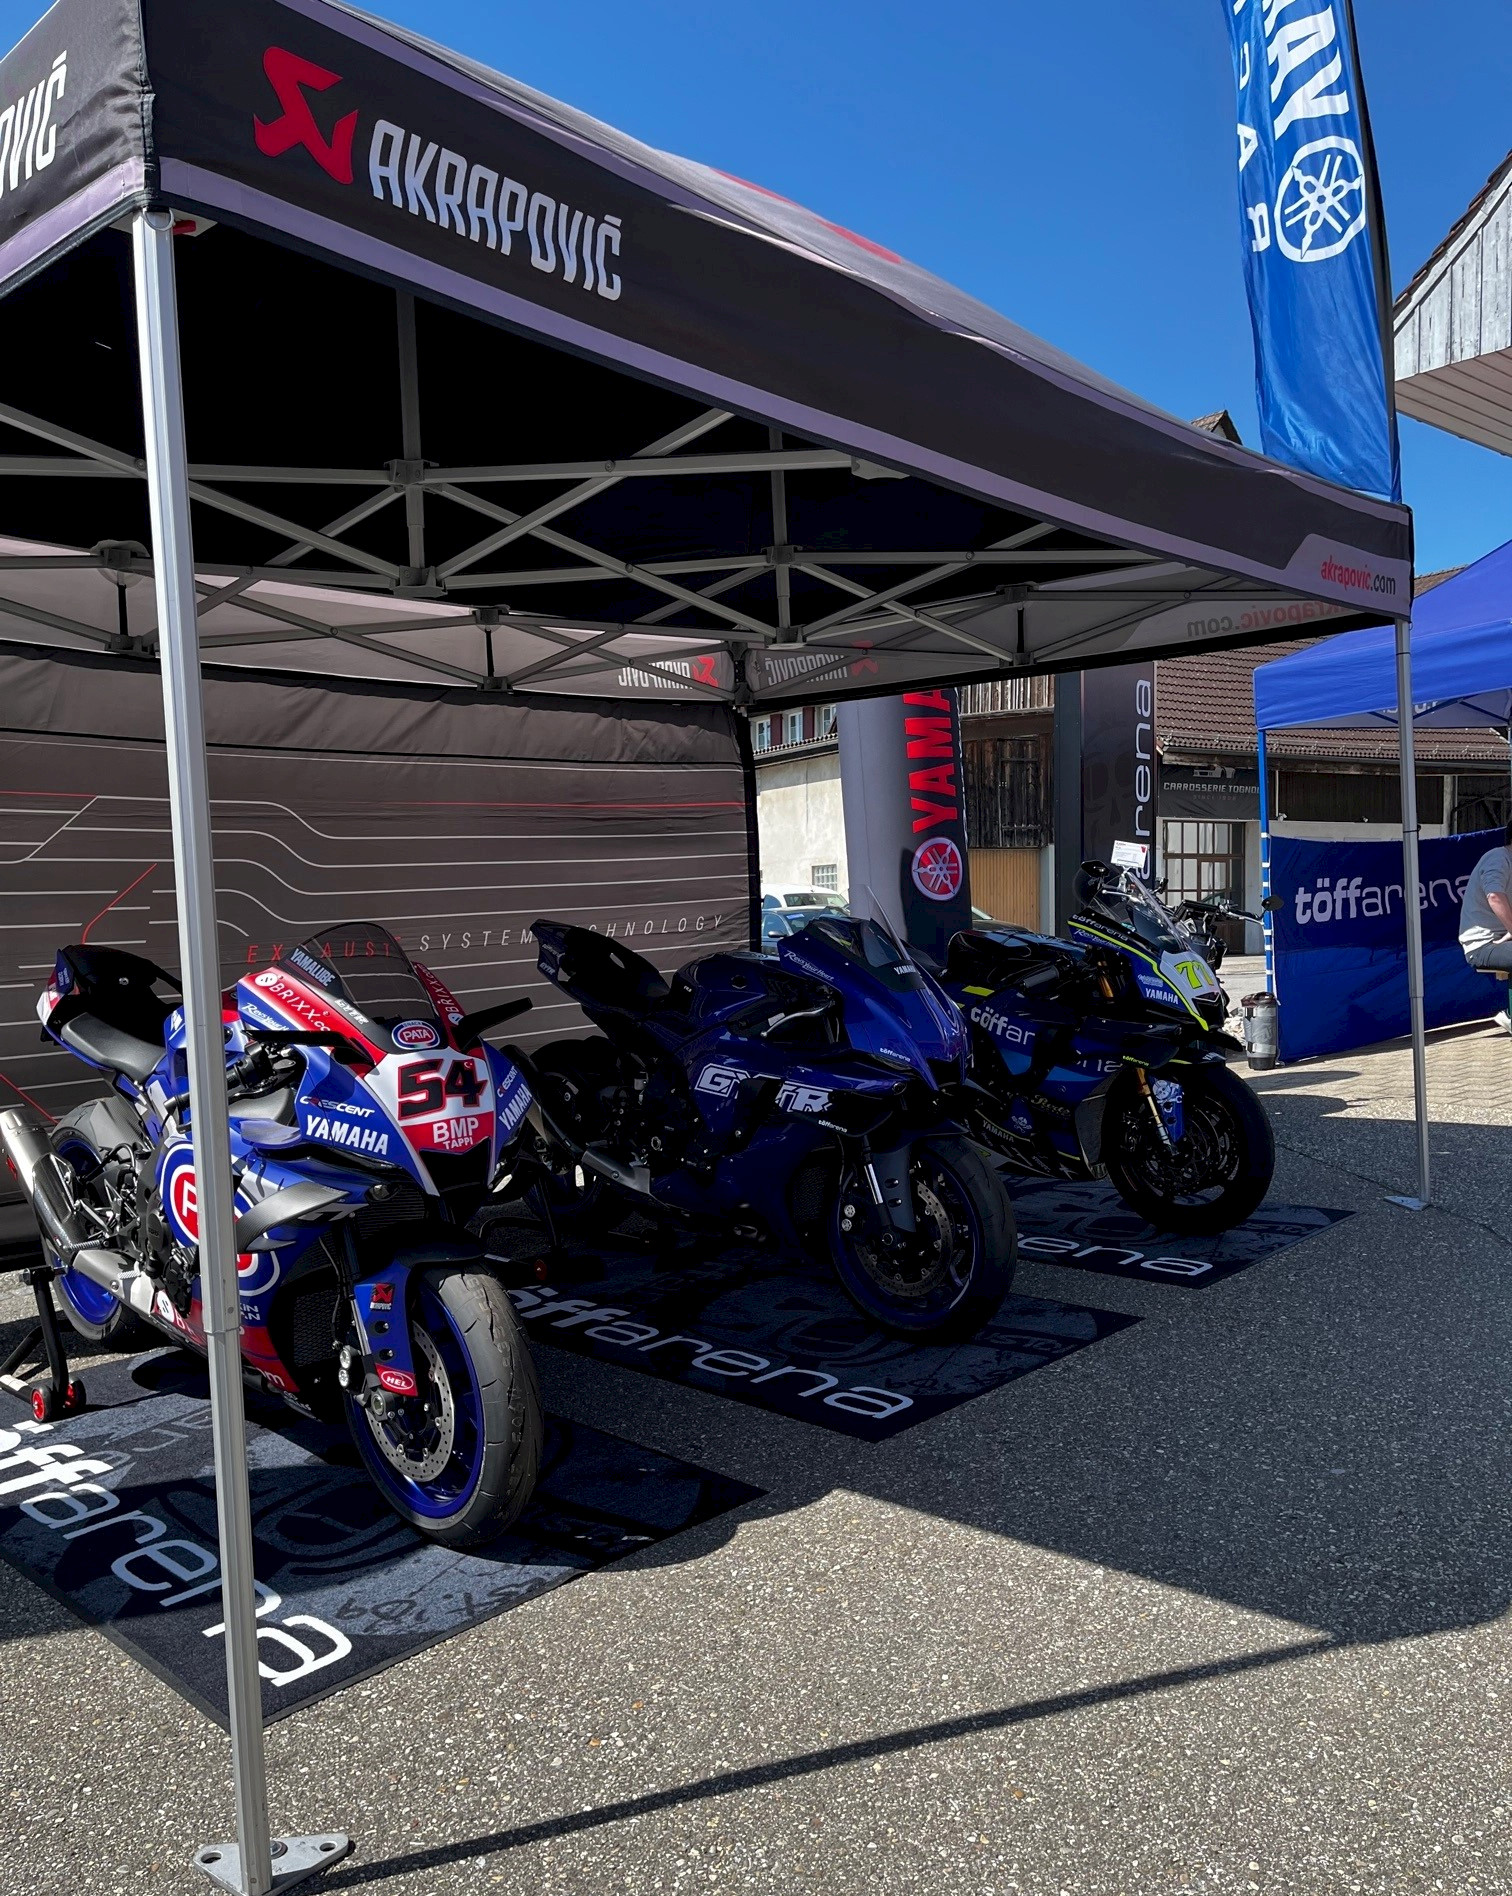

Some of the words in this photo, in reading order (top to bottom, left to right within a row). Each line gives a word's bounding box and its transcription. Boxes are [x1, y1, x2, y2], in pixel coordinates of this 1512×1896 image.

[1320, 555, 1396, 595] akrapovic.com
[1163, 782, 1226, 793] CARROSSERIE
[247, 936, 401, 963] EXAUST
[420, 928, 534, 951] SYSTEM
[290, 948, 336, 987] YAMALUBE
[1145, 987, 1179, 1005] YAMAHA
[403, 1028, 431, 1041] PATA
[398, 1058, 489, 1121] 54
[498, 1083, 532, 1131] YAMAHA
[306, 1114, 388, 1156] YAMAHA
[432, 1117, 479, 1144] BMP
[442, 1136, 473, 1151] TAPPI
[386, 1375, 408, 1388] HEL
